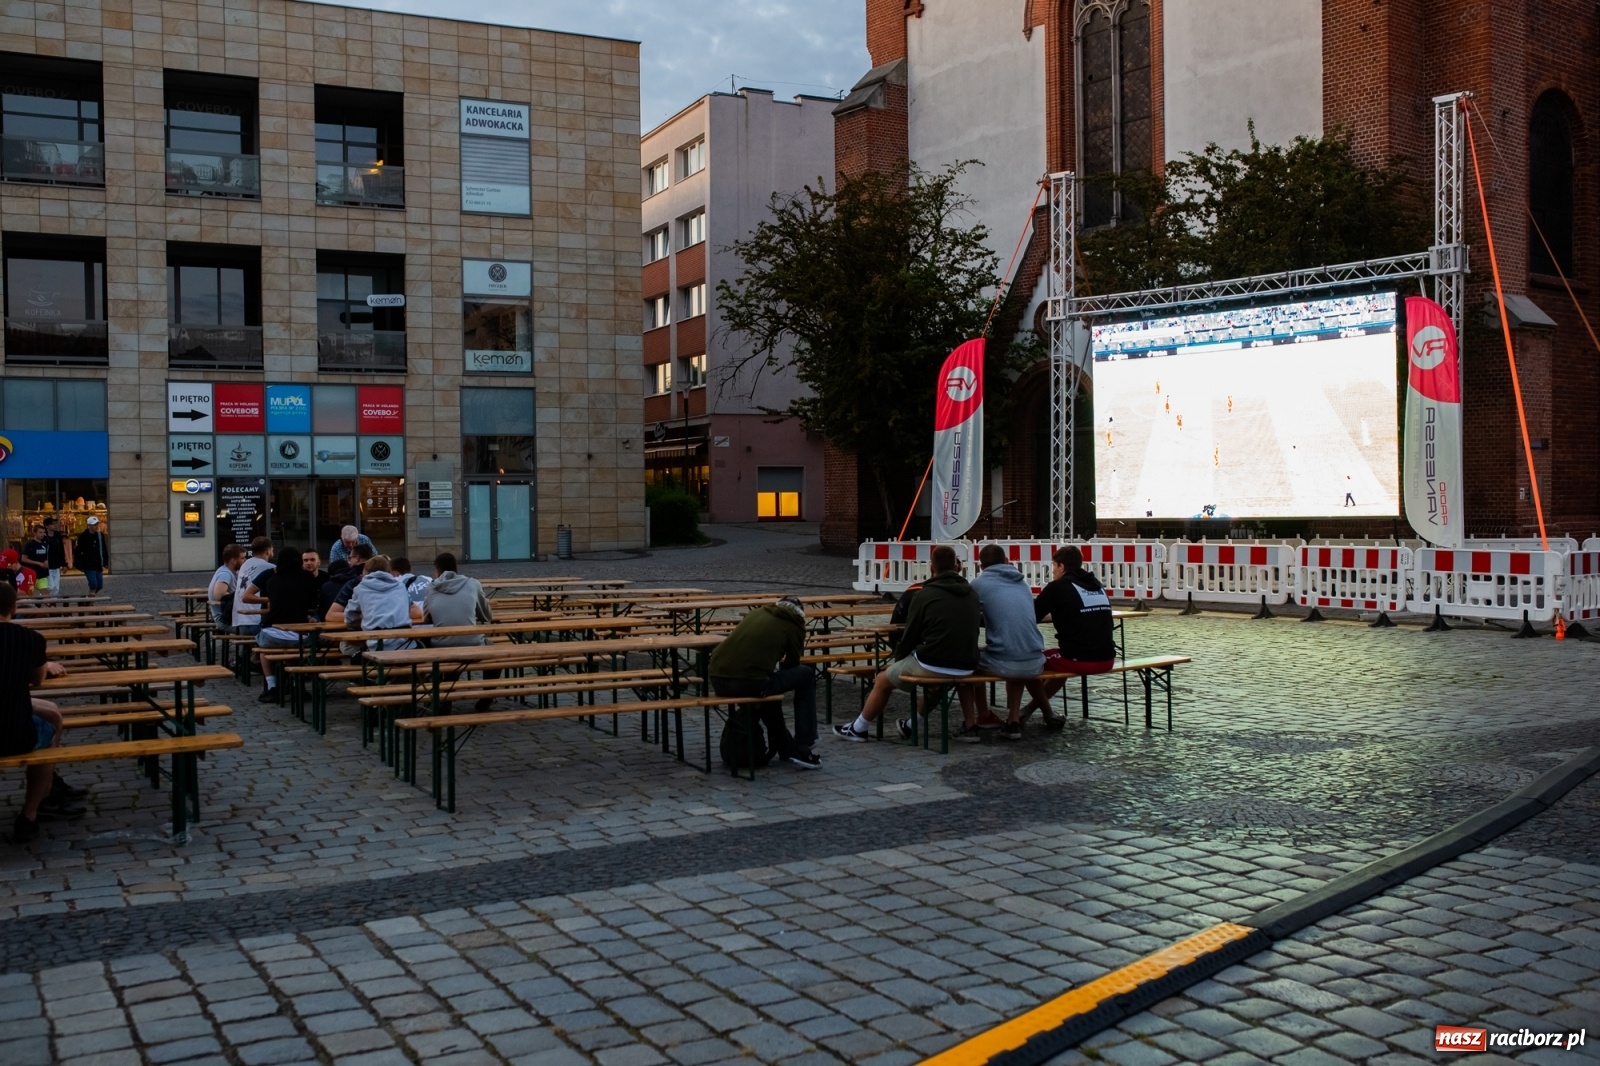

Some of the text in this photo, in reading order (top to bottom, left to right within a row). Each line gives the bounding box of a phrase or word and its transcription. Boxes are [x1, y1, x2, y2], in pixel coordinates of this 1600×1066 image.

[466, 106, 522, 118] KANCELARIA
[466, 118, 524, 131] ADWOKACKA
[180, 395, 210, 404] PIĘTRO
[270, 396, 306, 406] MUPOL
[178, 442, 211, 451] PIĘTRO
[951, 432, 961, 525] VANESSA
